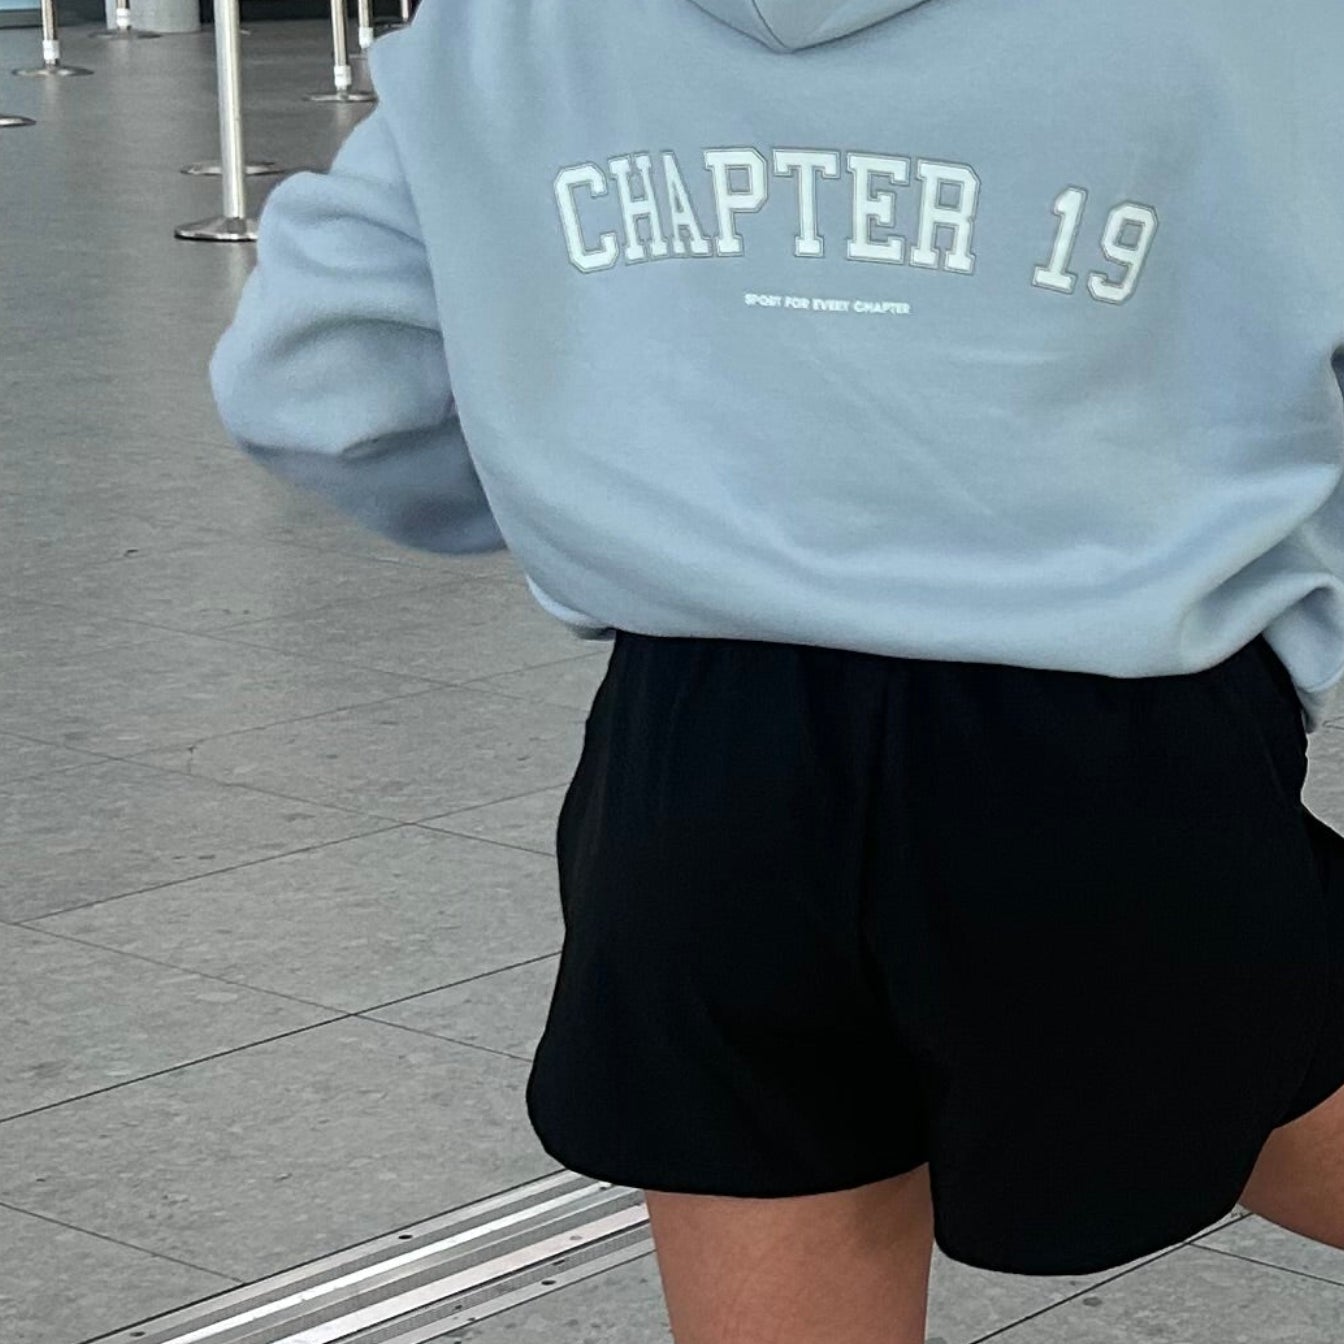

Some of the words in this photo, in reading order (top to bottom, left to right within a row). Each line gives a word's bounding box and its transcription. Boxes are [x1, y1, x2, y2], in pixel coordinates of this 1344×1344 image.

[554, 147, 981, 274] CHAPTER
[1032, 184, 1159, 305] 19
[745, 293, 781, 306] SPORT
[785, 296, 809, 308] FOR
[813, 298, 849, 311] EVERY
[854, 300, 911, 314] CHAPTER
